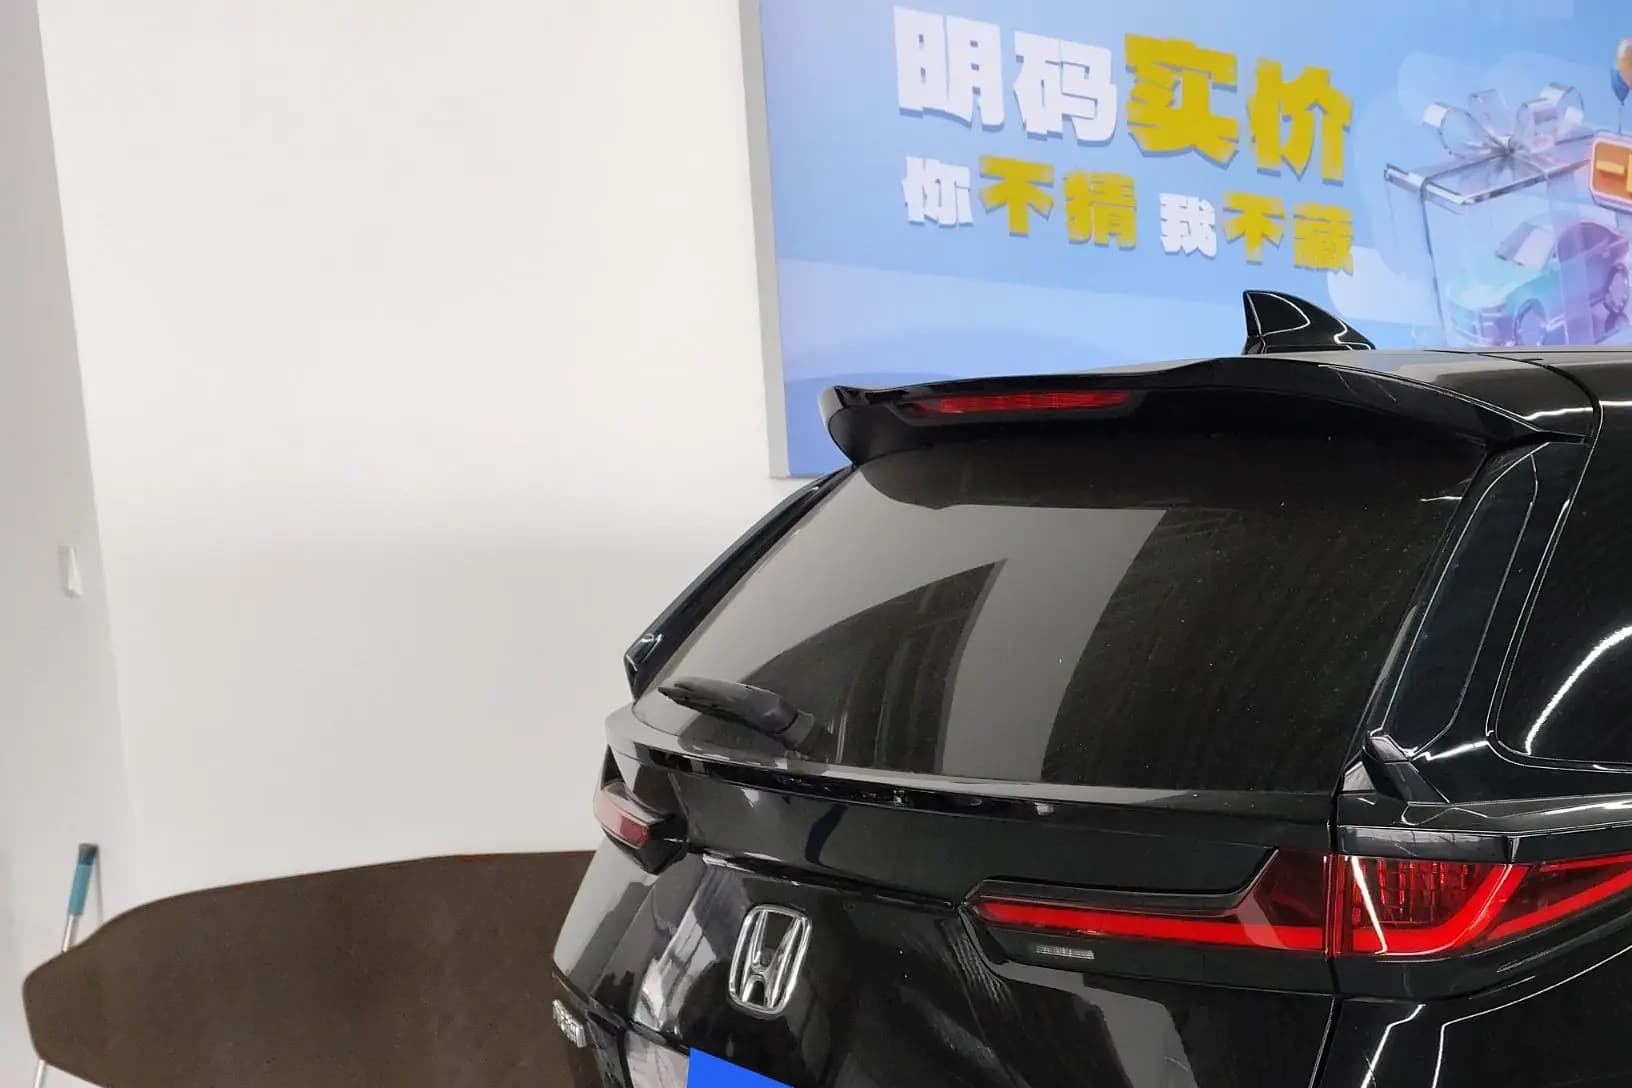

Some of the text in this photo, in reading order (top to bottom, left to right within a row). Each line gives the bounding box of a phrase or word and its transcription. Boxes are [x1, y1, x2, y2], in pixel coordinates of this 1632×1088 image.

[894, 6, 1353, 183] 明码实价
[903, 155, 1353, 273] 你不猜 我不藏
